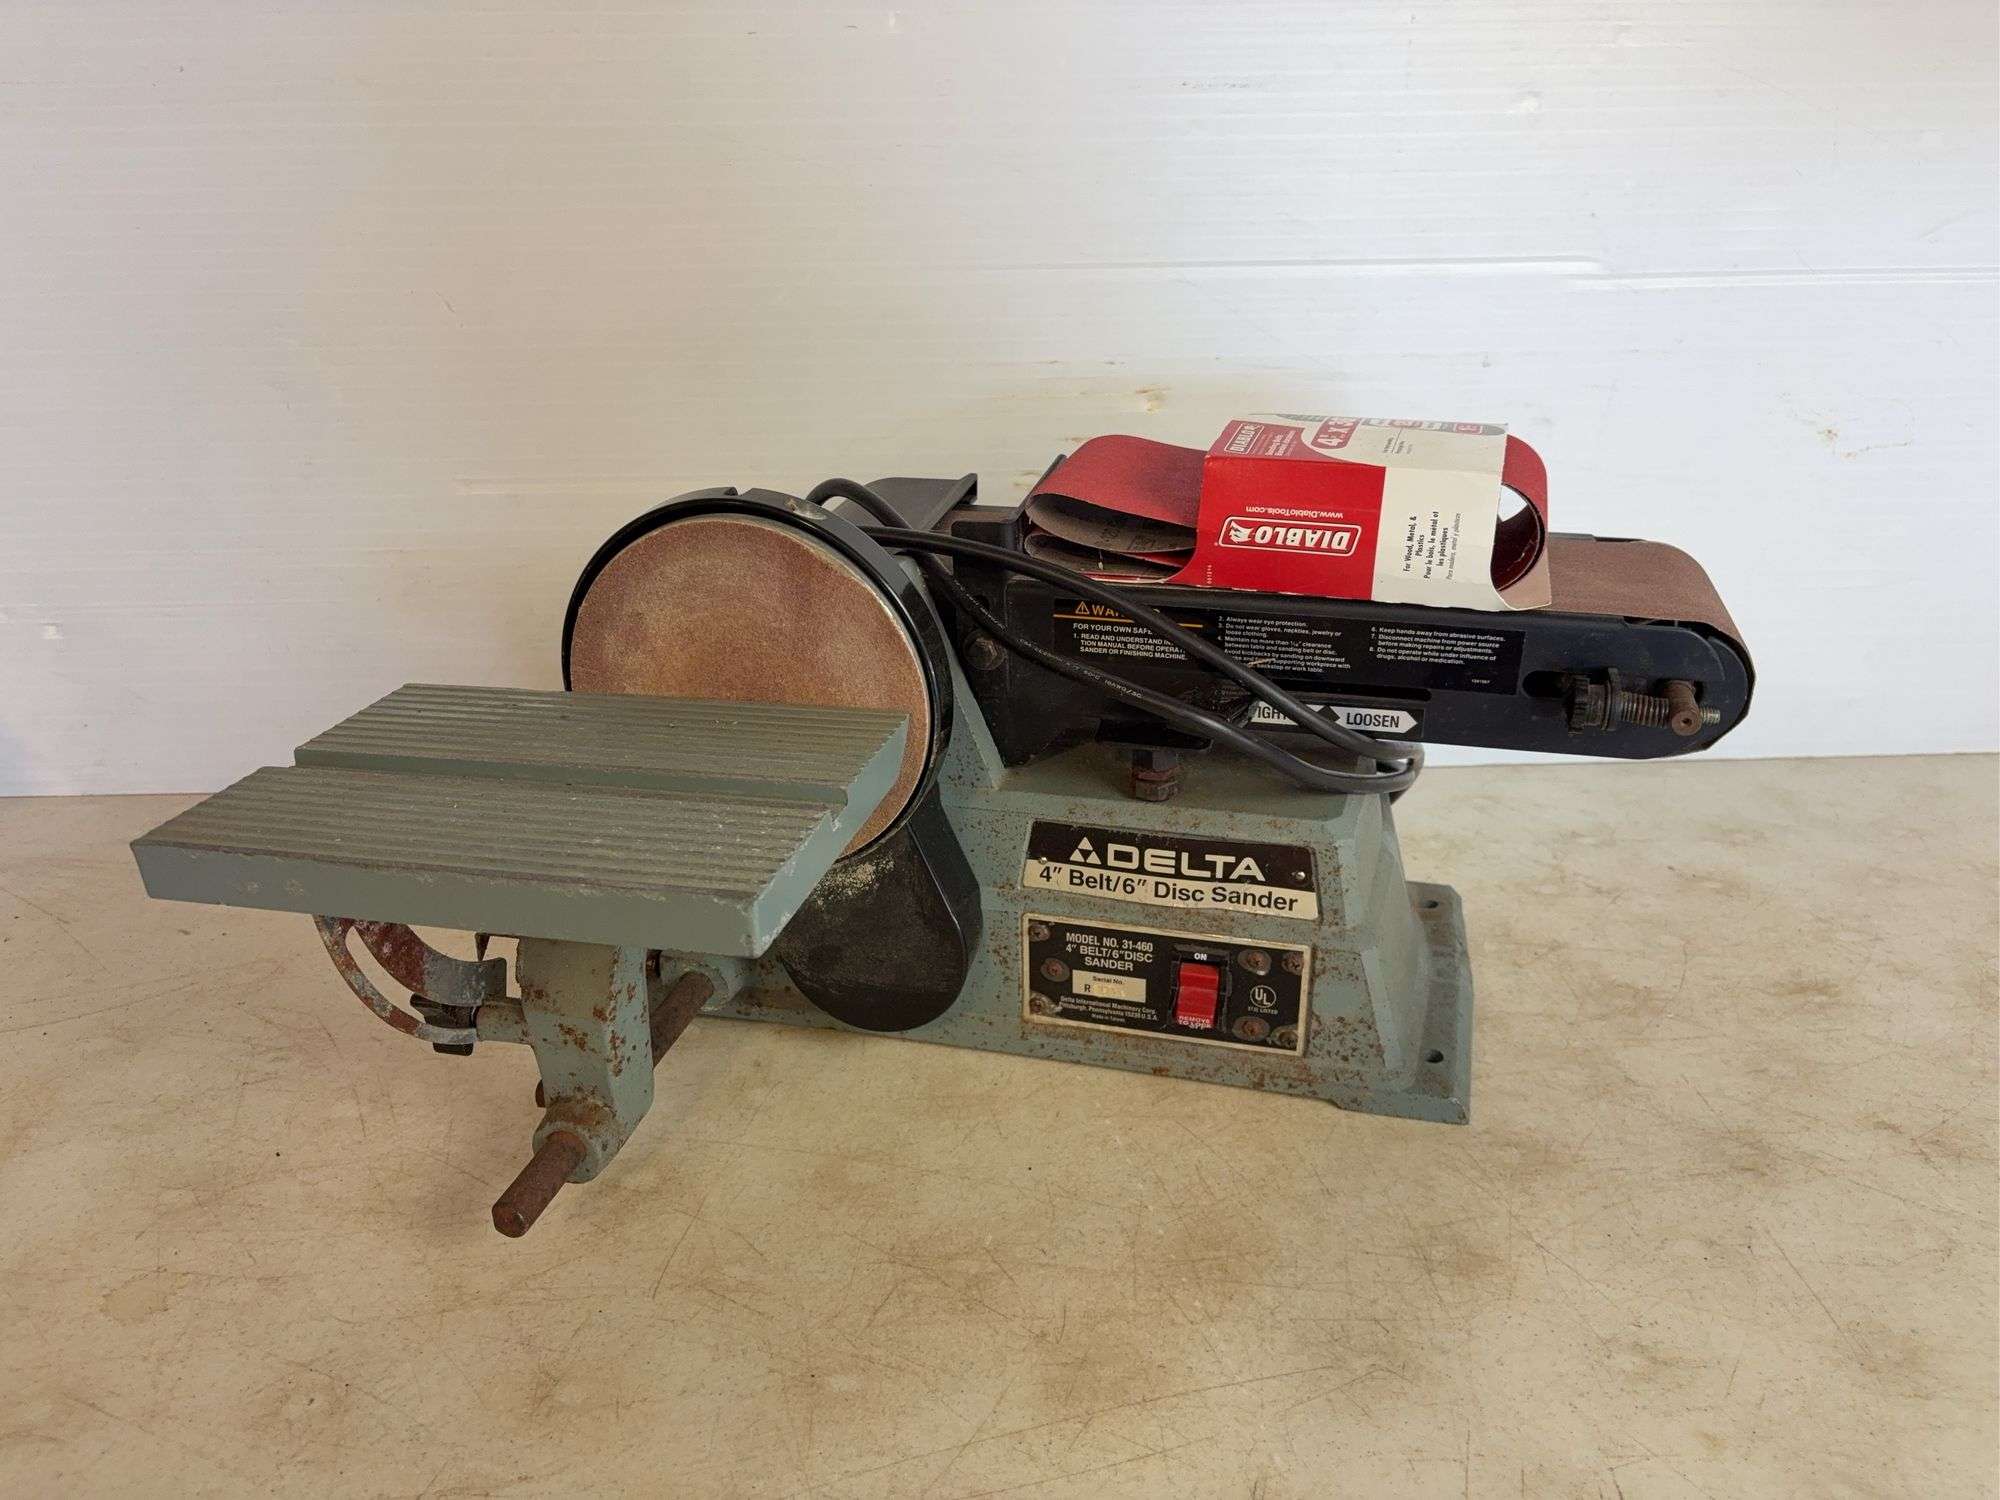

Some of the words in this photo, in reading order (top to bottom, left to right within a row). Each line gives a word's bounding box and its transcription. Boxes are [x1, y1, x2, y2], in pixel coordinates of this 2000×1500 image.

[1246, 506, 1344, 519] www.DiabloTools.com
[1255, 526, 1351, 551] DIABLO
[1438, 528, 1449, 557] plastiques
[1415, 535, 1425, 556] Plastics
[1405, 545, 1414, 561] Wood,
[1403, 563, 1411, 572] For
[1073, 623, 1089, 631] FOR
[1311, 629, 1333, 637] jewelry
[1378, 634, 1414, 642] Disconnect
[1098, 641, 1126, 649] MANUAL
[1128, 643, 1154, 651] BEFORE
[1117, 636, 1162, 645] UNDERSTAND
[1120, 649, 1154, 658] FINISHING
[1313, 655, 1345, 663] downward
[1346, 712, 1400, 728] LOOSEN
[1107, 843, 1266, 882] DELTA
[1039, 865, 1062, 882] 4"
[1154, 881, 1205, 902] Disc
[1211, 887, 1298, 912] Sander
[1066, 932, 1100, 946] MODEL
[1103, 937, 1119, 948] NO.
[1122, 940, 1153, 952] 31-460
[1066, 943, 1077, 953] 4"
[1194, 952, 1208, 961] ON
[1084, 956, 1134, 971] SANDER
[1084, 984, 1091, 992] R
[1255, 988, 1271, 1006] UL
